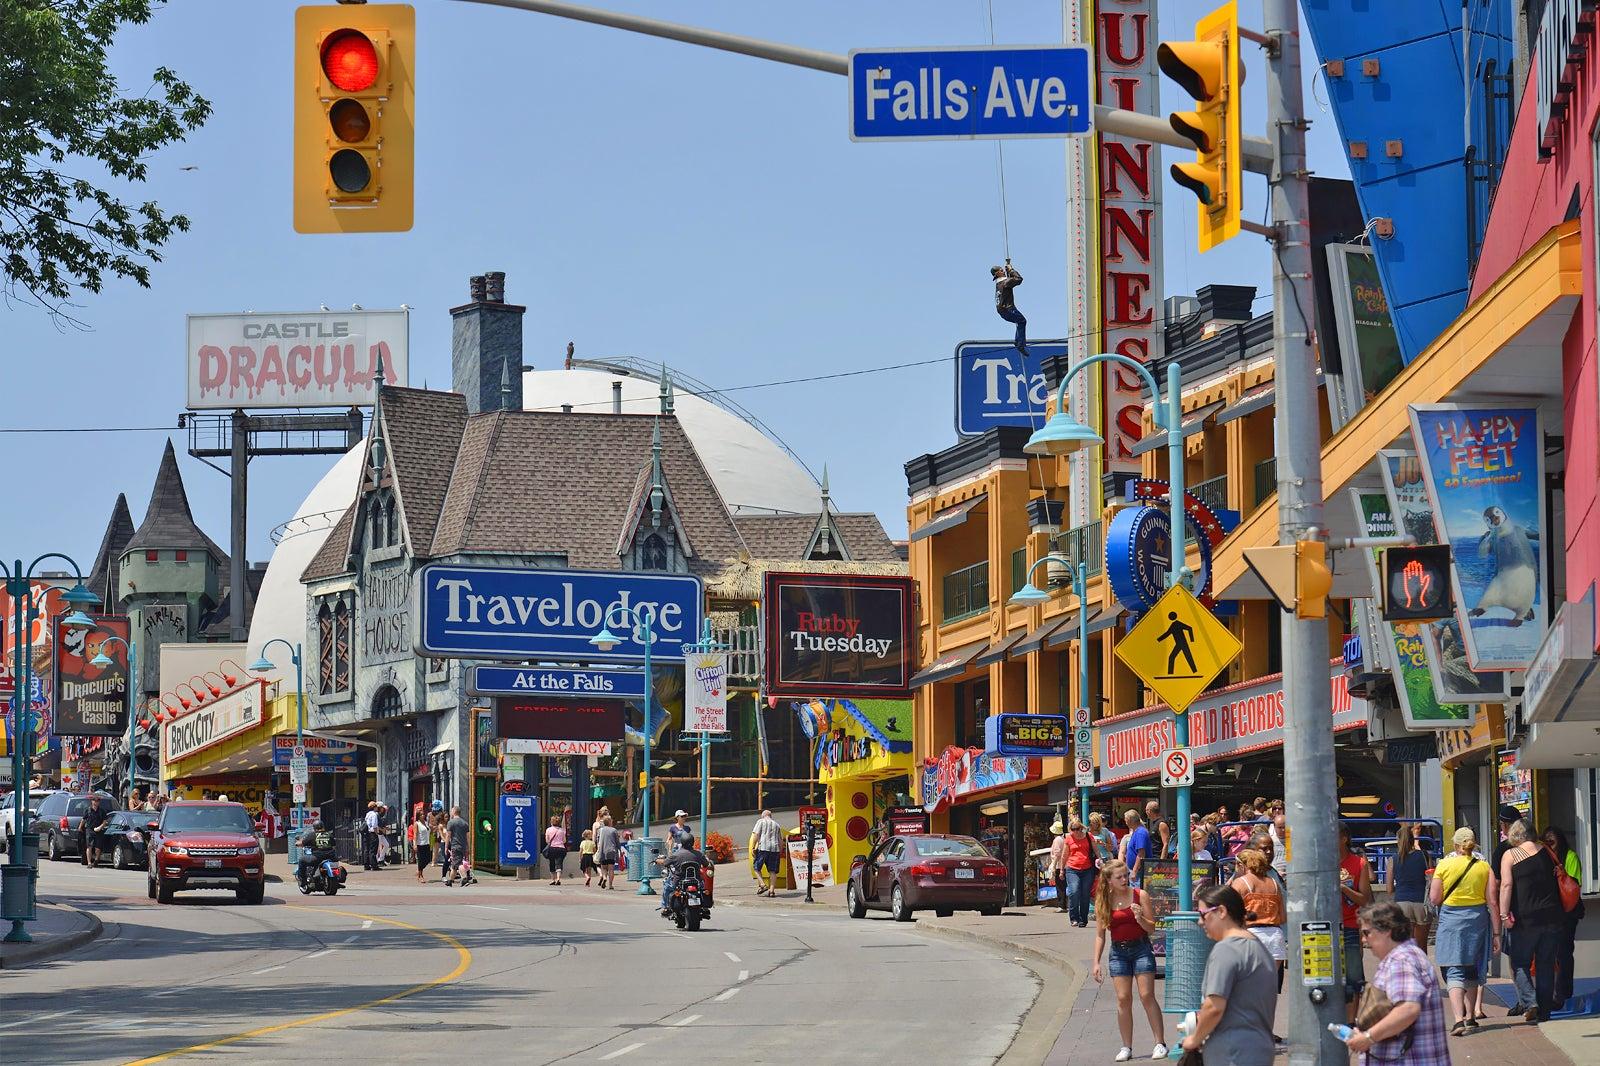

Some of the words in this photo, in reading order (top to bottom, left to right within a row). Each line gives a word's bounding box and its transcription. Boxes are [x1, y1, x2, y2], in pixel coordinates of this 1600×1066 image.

[865, 67, 968, 121] Falls
[984, 66, 1079, 119] Ave.
[1100, 0, 1153, 458] UINNESS
[243, 322, 349, 340] CASTLE
[197, 341, 398, 400] DRACULA
[1436, 415, 1525, 449] HAPPY
[1450, 441, 1517, 476] FEET
[1366, 523, 1395, 532] DININ
[1371, 513, 1386, 521] AN
[1137, 549, 1155, 598] WORLD
[363, 569, 411, 613] HAUNTED
[144, 606, 186, 637] THRILLER
[435, 577, 683, 645] Travelodge
[797, 611, 861, 636] Ruby
[364, 610, 409, 658] HOUSE
[790, 630, 893, 659] Tuesday
[63, 671, 125, 701] DRACULA'S
[512, 672, 536, 689] At
[540, 673, 569, 690] the
[573, 673, 614, 692] Falls
[695, 665, 725, 681] Clifton
[703, 677, 721, 692] Hill
[77, 699, 123, 713] Haunted
[82, 711, 117, 725] Castle
[695, 707, 705, 715] The
[706, 707, 724, 715] Street
[277, 738, 327, 748] RESTOOMS
[1018, 727, 1050, 740] BIG
[1106, 719, 1169, 769] GUINNESS
[1220, 690, 1286, 741] RECORDS
[538, 740, 610, 754] VACANCY
[514, 806, 524, 851] VACANCY
